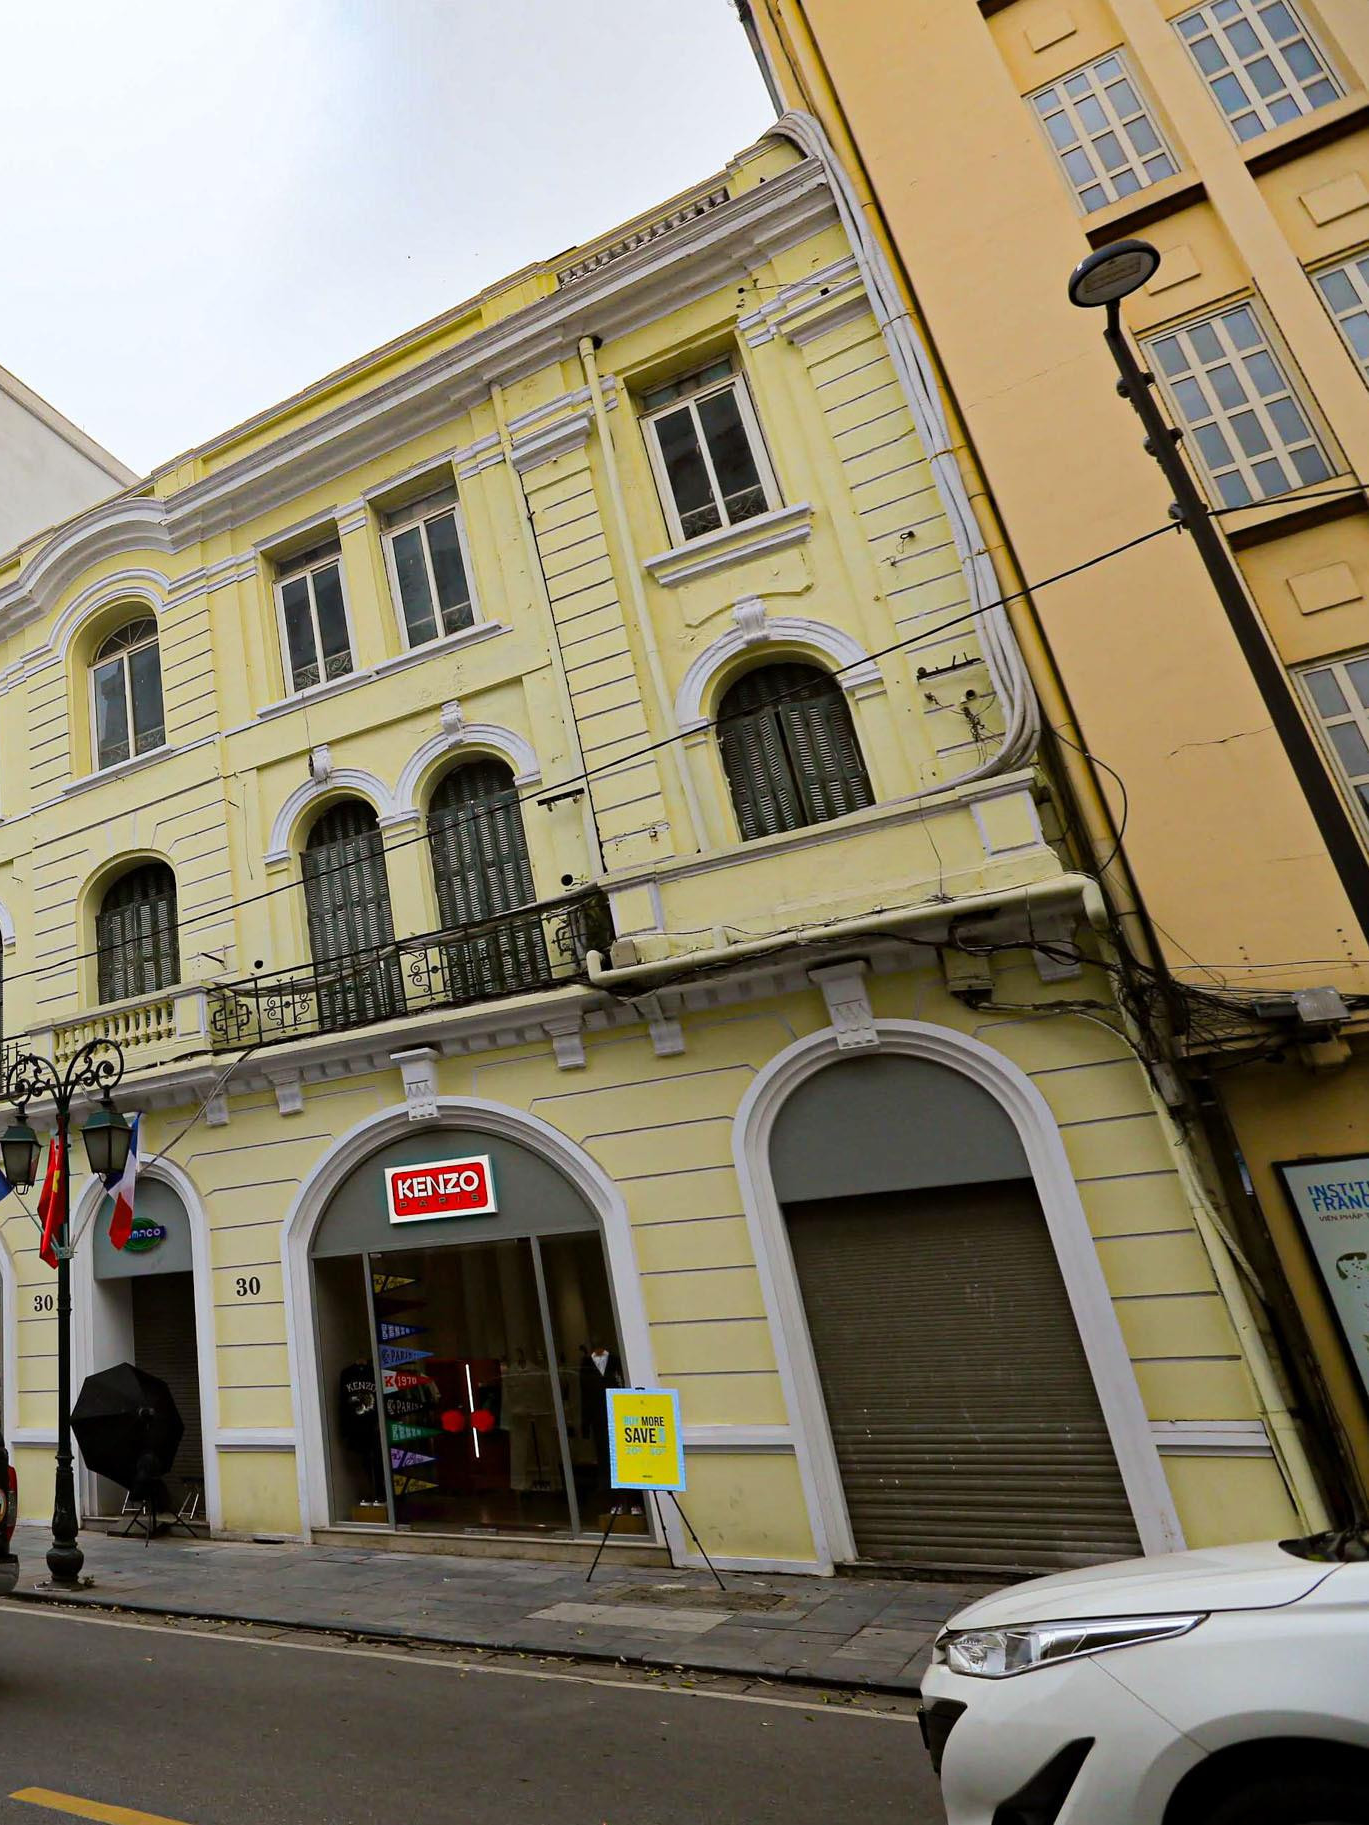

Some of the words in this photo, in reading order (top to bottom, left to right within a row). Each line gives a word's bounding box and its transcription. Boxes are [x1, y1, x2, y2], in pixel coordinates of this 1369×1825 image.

[397, 1170, 479, 1200] KENZO
[1307, 1181, 1369, 1198] INSTIT
[400, 1193, 479, 1208] PARIS
[236, 1276, 261, 1297] 30
[34, 1294, 54, 1312] 30
[397, 1375, 417, 1387] 1970
[641, 1416, 665, 1427] MORE
[624, 1427, 657, 1444] SAVE
